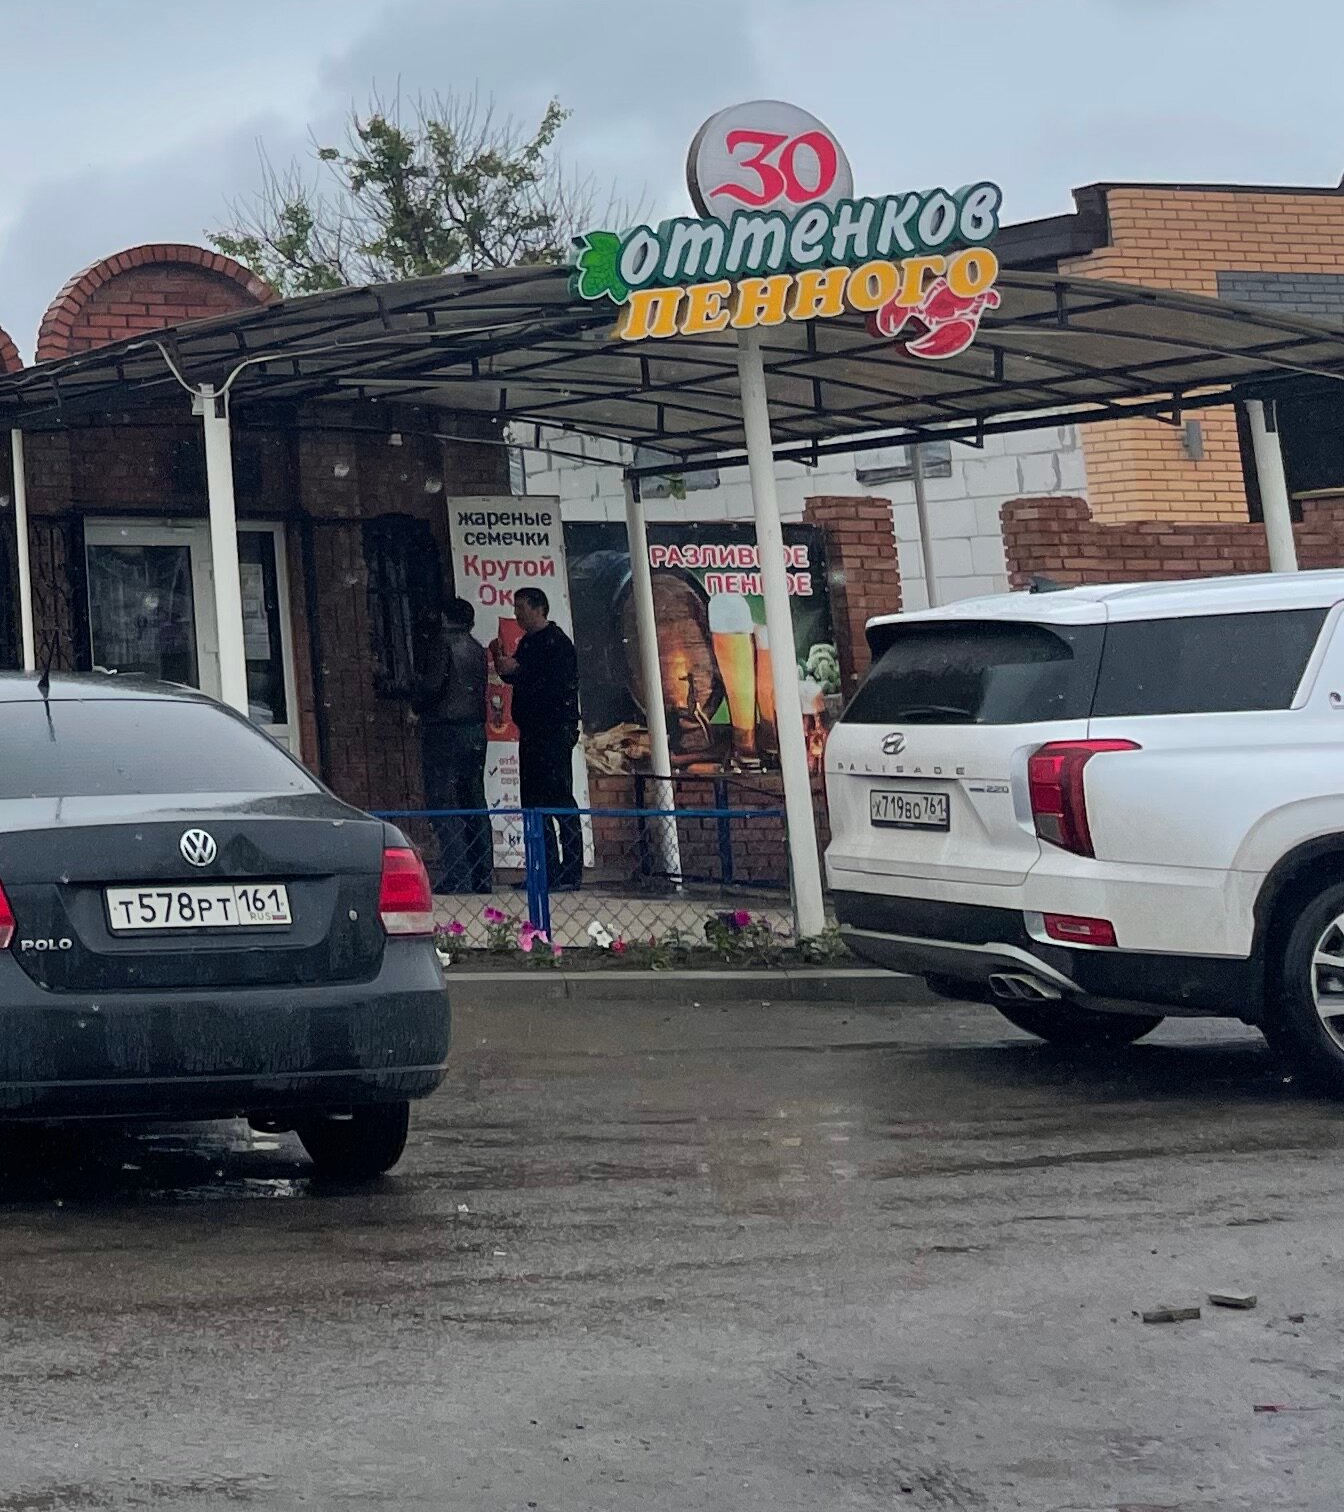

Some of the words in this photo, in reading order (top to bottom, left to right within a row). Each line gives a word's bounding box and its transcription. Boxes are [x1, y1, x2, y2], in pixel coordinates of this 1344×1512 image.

[710, 129, 838, 206] 30
[621, 248, 1000, 340] ПЕННОГО
[458, 512, 552, 529] жареные
[463, 531, 549, 546] семечки
[463, 554, 555, 581] Крутой
[837, 762, 966, 775] PALISADE
[923, 796, 943, 816] 761
[119, 892, 232, 924] Т578РТ
[238, 888, 282, 913] 161
[250, 912, 272, 921] RUS
[21, 938, 73, 951] POLO
